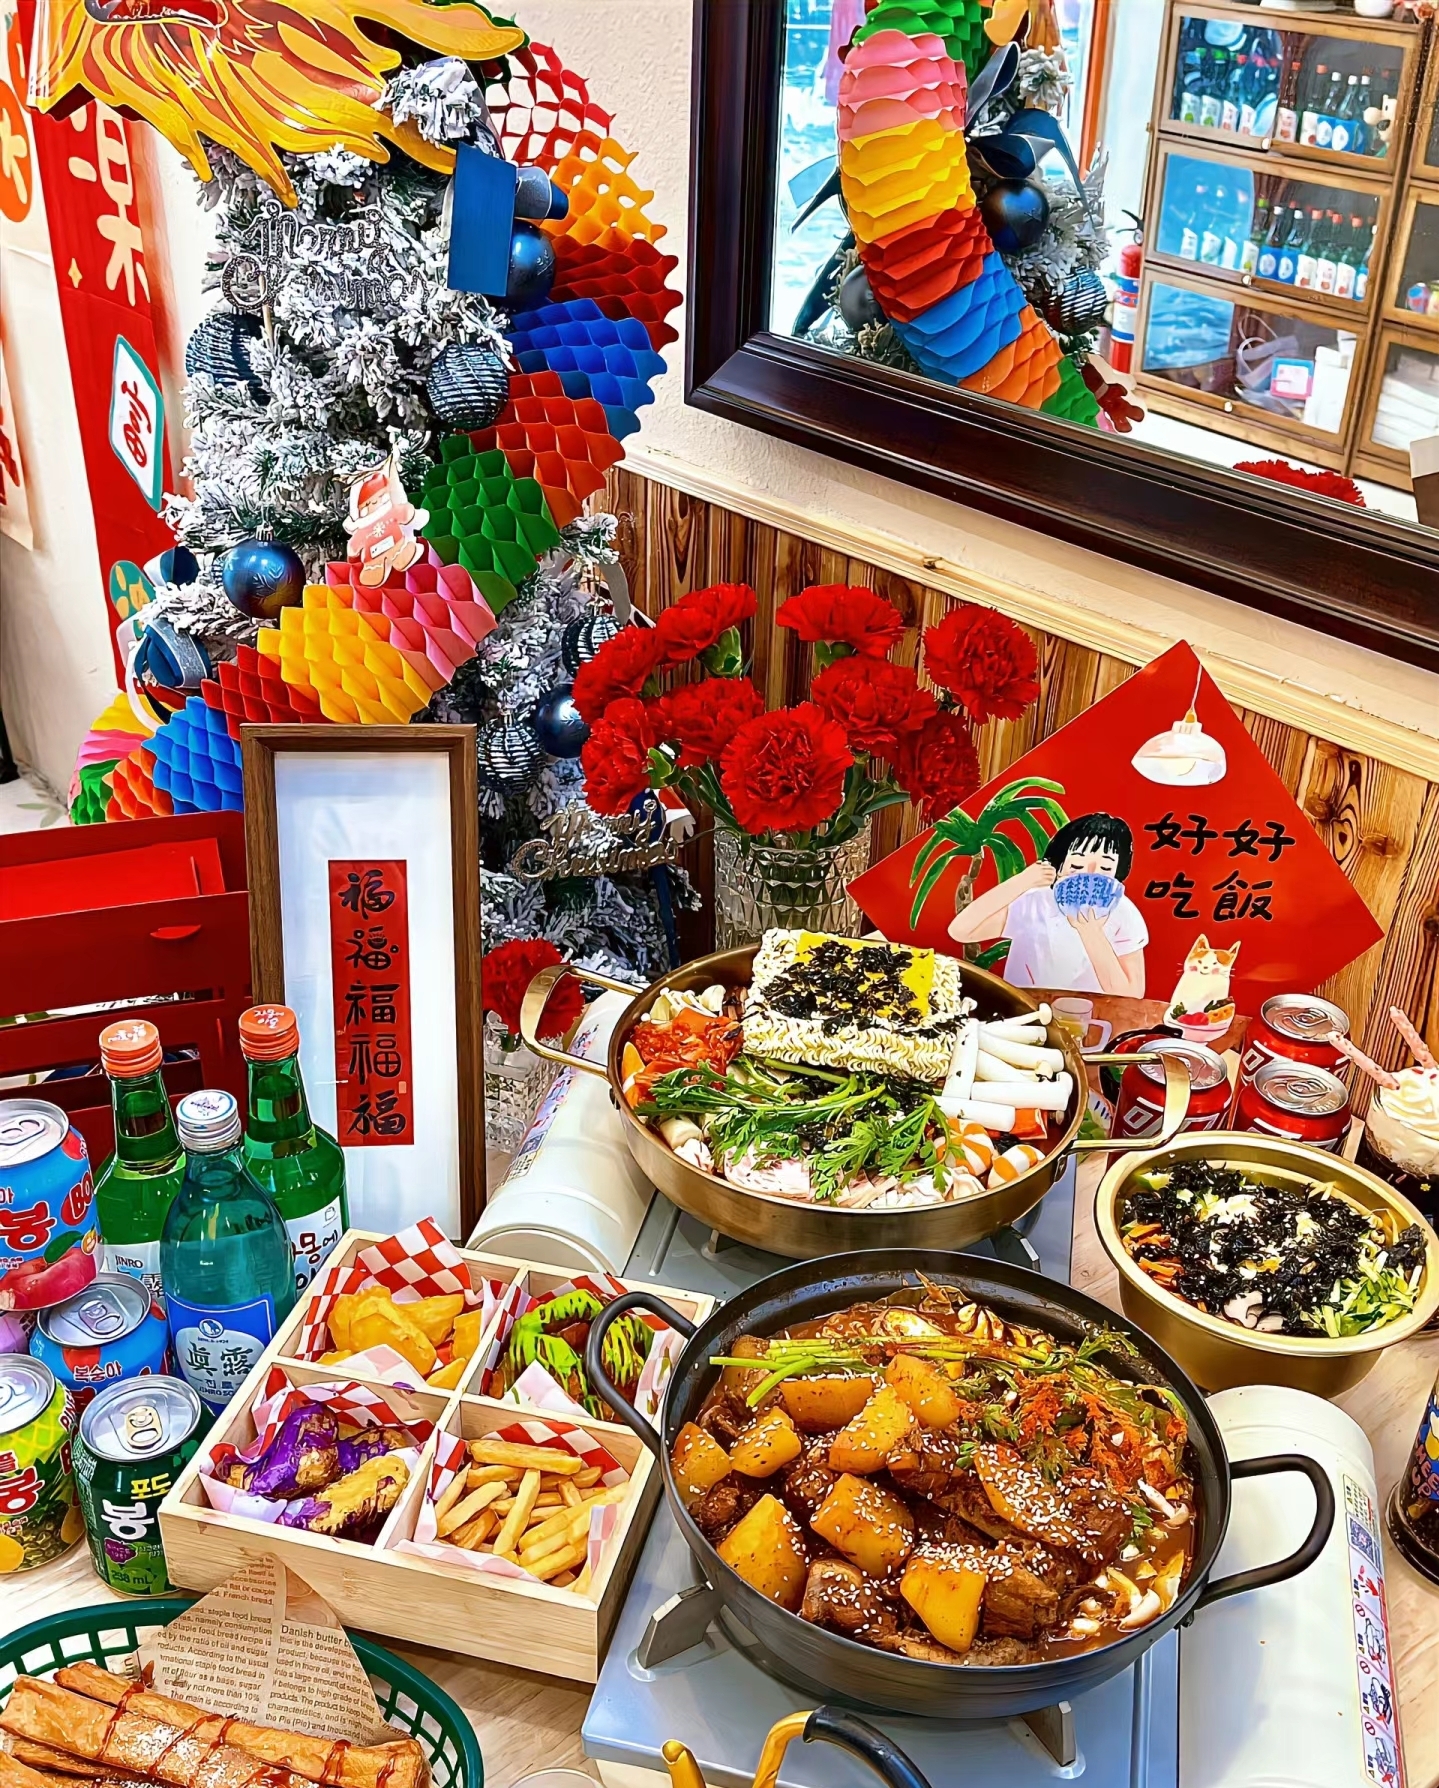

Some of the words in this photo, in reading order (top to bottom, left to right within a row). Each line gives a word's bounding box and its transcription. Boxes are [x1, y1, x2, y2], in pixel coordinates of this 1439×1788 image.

[1144, 812, 1296, 862] 好好
[1144, 870, 1274, 922] 吃飯
[115, 1254, 143, 1268] JINRO
[74, 1360, 122, 1382] 복숭아
[131, 1472, 172, 1499] 포도
[199, 1626, 215, 1636] food
[217, 1629, 239, 1640] bread
[281, 1624, 314, 1640] Danish
[316, 1631, 343, 1646] butter
[193, 1636, 210, 1646] ratio
[187, 1646, 225, 1660] According
[219, 1662, 235, 1674] food
[185, 1693, 204, 1704] main
[206, 1685, 225, 1695] more
[226, 1687, 242, 1699] than
